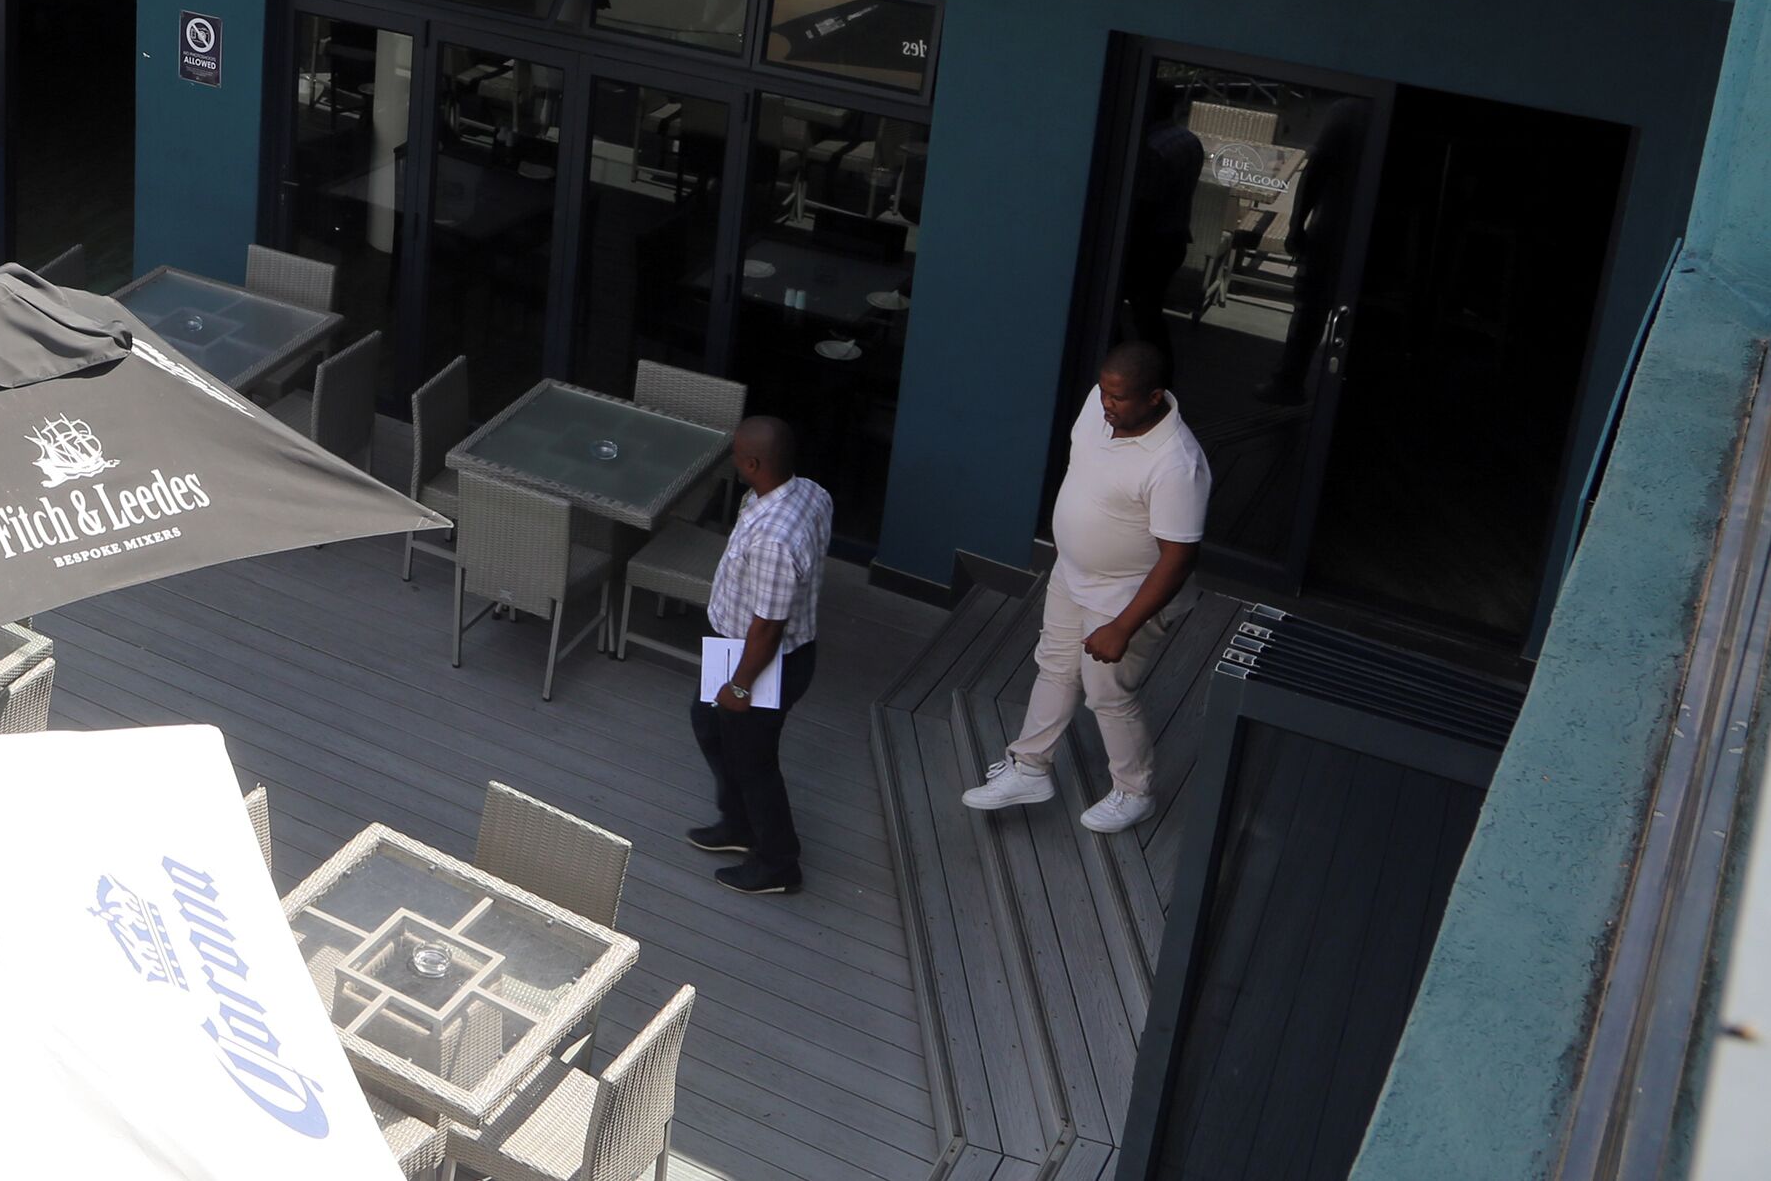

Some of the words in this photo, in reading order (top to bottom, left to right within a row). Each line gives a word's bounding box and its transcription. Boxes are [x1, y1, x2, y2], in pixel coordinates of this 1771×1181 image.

[184, 56, 217, 69] ALLOWED
[1222, 158, 1250, 171] BLUE
[1240, 171, 1290, 189] LAGOON
[70, 489, 106, 536] &
[92, 468, 211, 531] Leedes
[53, 542, 122, 568] BESPOKE
[122, 526, 182, 551] MIXERS
[161, 855, 329, 1139] Corona
